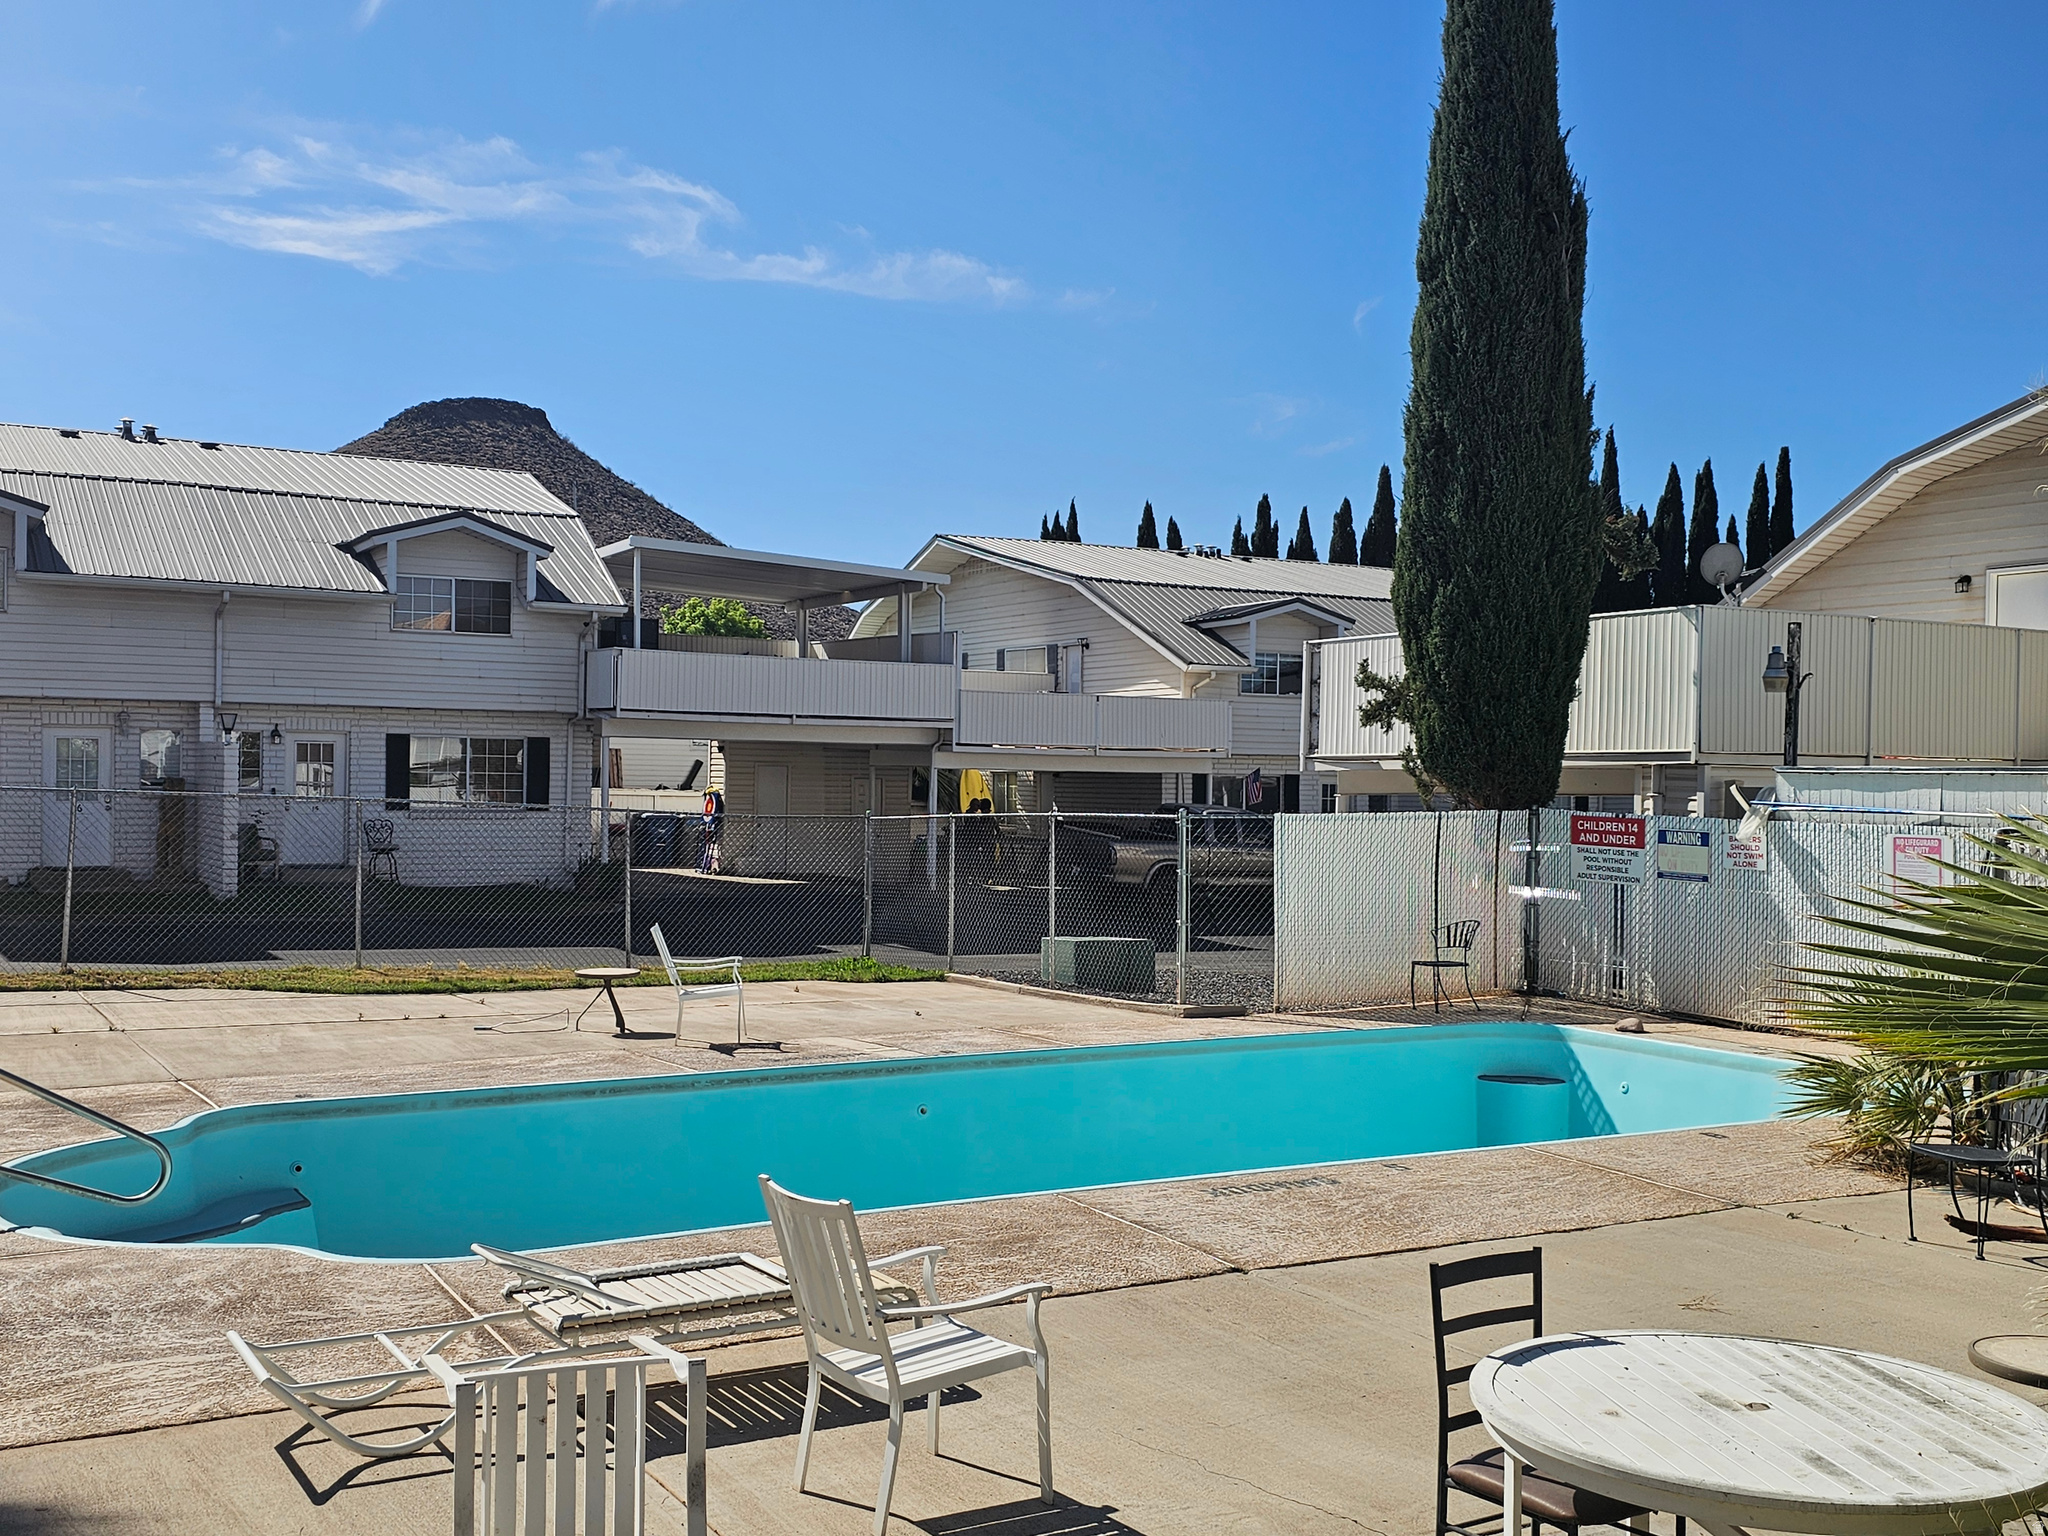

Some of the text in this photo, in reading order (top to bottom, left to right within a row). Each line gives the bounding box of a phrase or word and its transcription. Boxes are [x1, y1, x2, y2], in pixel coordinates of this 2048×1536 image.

[1577, 820, 1638, 833] CHILDREN 14
[1579, 832, 1636, 846] AND UNDER
[1665, 830, 1702, 846] WARNING
[1728, 835, 1762, 844] BARS
[1896, 838, 1904, 846] NO
[1576, 846, 1640, 858] SHALL NOT USE THE
[1730, 843, 1761, 852] SHOULD
[1583, 855, 1633, 866] POOL WITHOUT
[1726, 851, 1764, 860] NOT SWIM
[1585, 864, 1629, 874] RESPONSIBLE
[1732, 860, 1758, 868] ALONE
[1576, 872, 1641, 884] ADULT SUPERVISION
